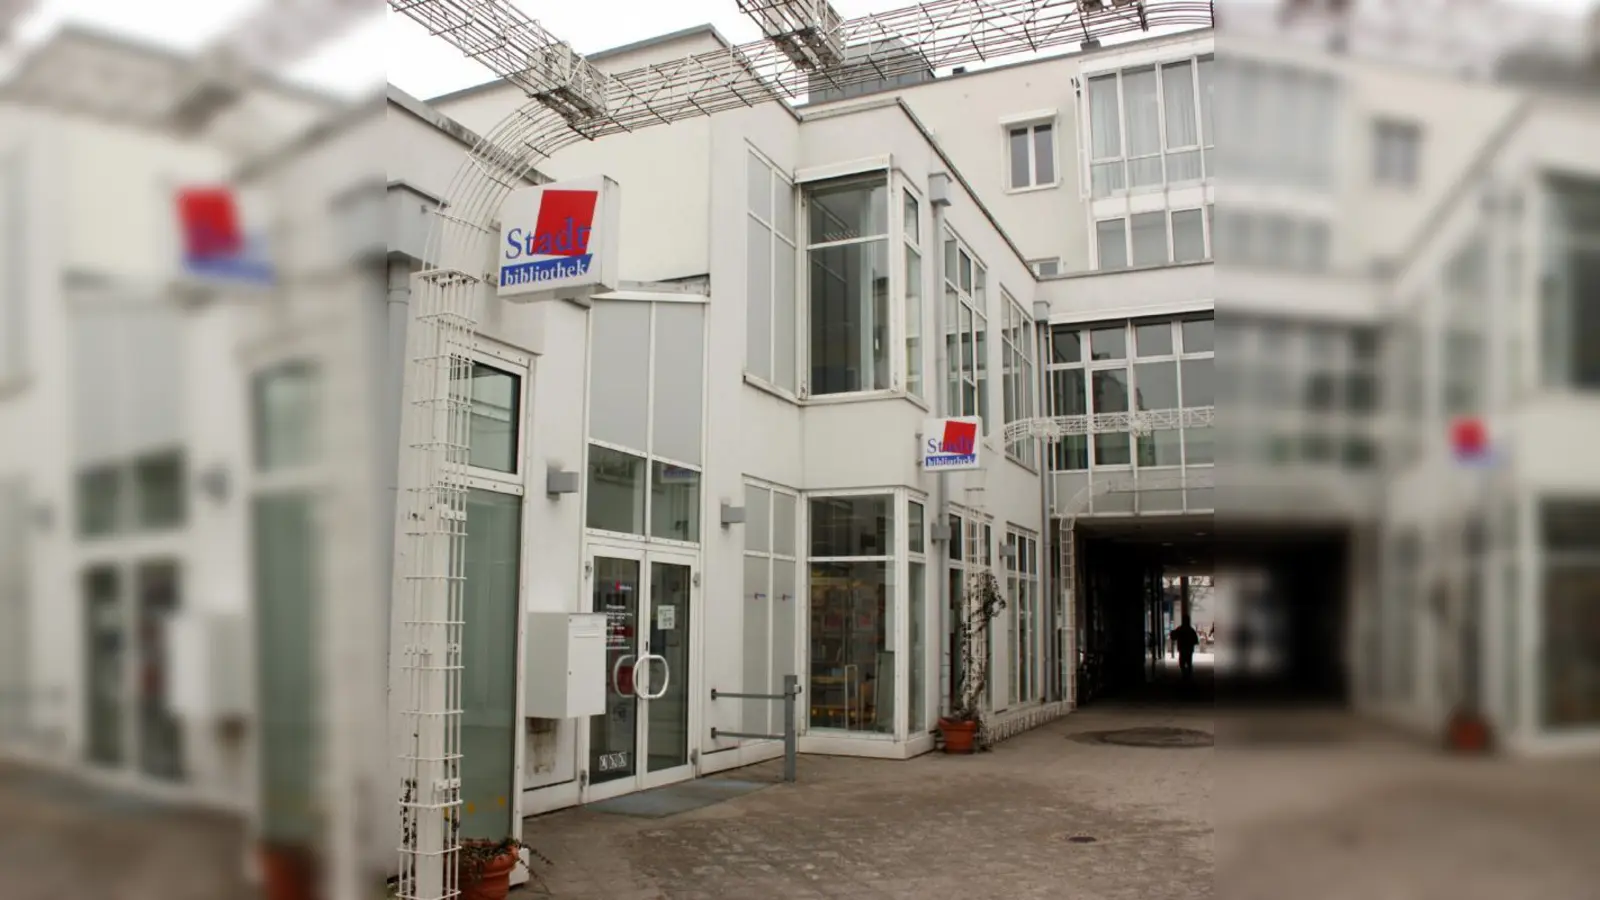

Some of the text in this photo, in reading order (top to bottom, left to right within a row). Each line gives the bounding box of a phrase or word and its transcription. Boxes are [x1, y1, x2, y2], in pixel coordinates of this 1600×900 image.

[505, 217, 592, 259] Stadt
[504, 259, 587, 286] bibliothek
[927, 432, 974, 453] Stadt
